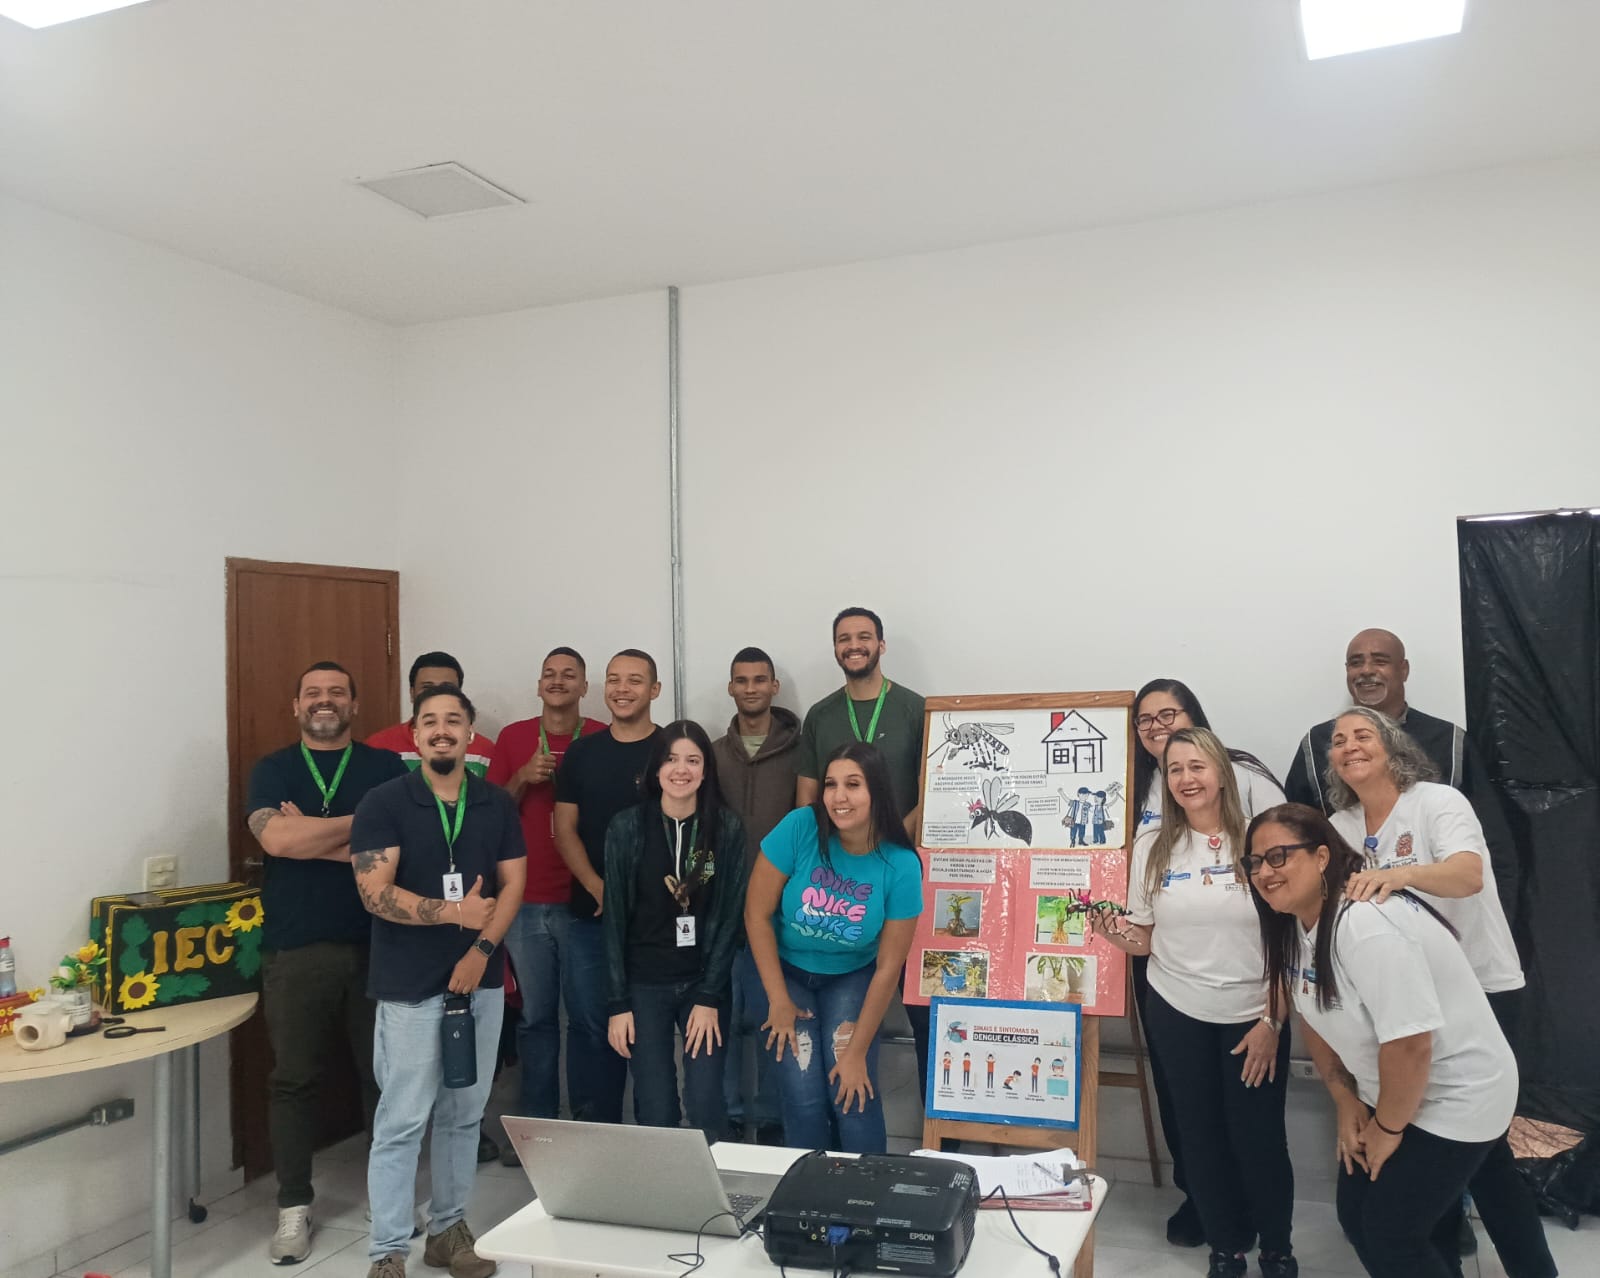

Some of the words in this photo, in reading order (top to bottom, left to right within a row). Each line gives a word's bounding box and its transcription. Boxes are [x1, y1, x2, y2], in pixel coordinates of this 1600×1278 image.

[812, 867, 873, 901] NIKE
[802, 887, 867, 922] NIKE
[795, 908, 863, 941] NIKE
[153, 923, 234, 975] IEC
[974, 1034, 1003, 1042] DENGUE
[1003, 1034, 1038, 1044] CLÁSSICA
[848, 1199, 875, 1207] EPSON
[910, 1233, 935, 1242] EPSON
